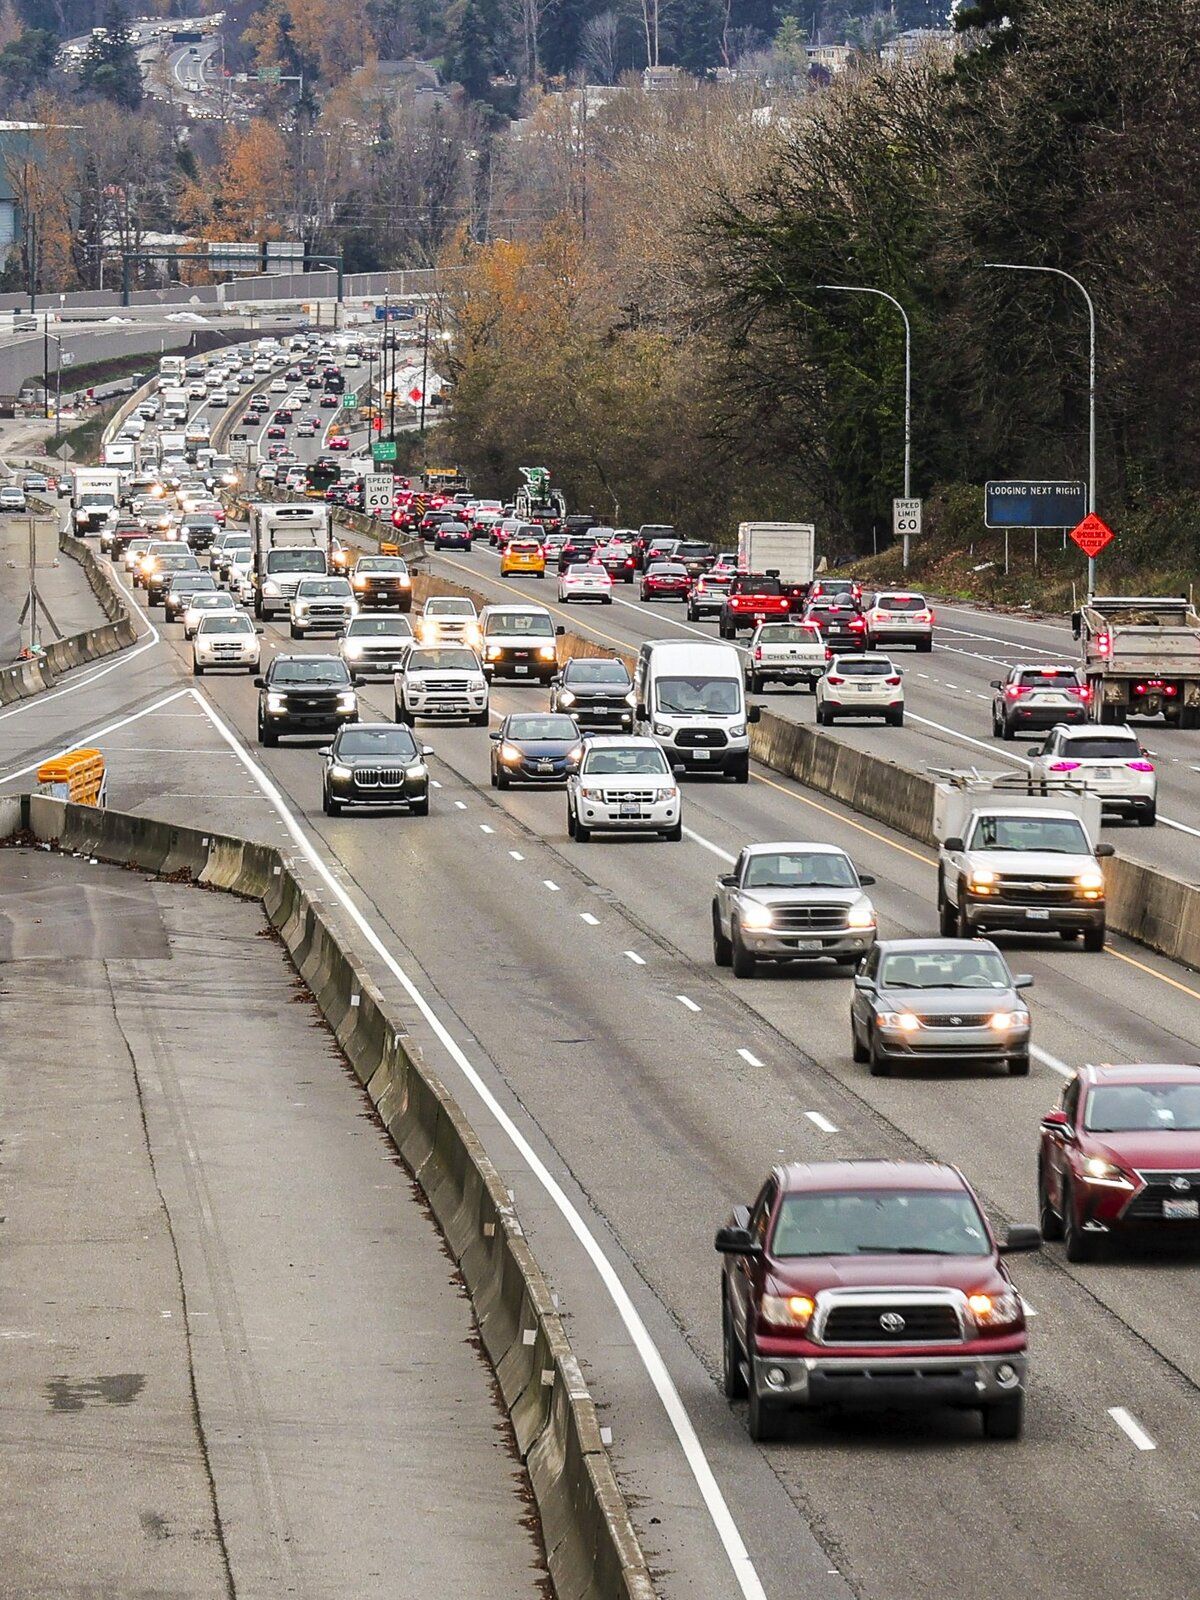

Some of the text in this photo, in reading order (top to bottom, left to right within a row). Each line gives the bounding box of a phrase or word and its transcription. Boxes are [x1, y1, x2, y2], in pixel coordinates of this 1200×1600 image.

[990, 486, 1080, 495] LODGING NEXT RIGHT
[370, 494, 389, 505] 60
[898, 519, 917, 530] 60
